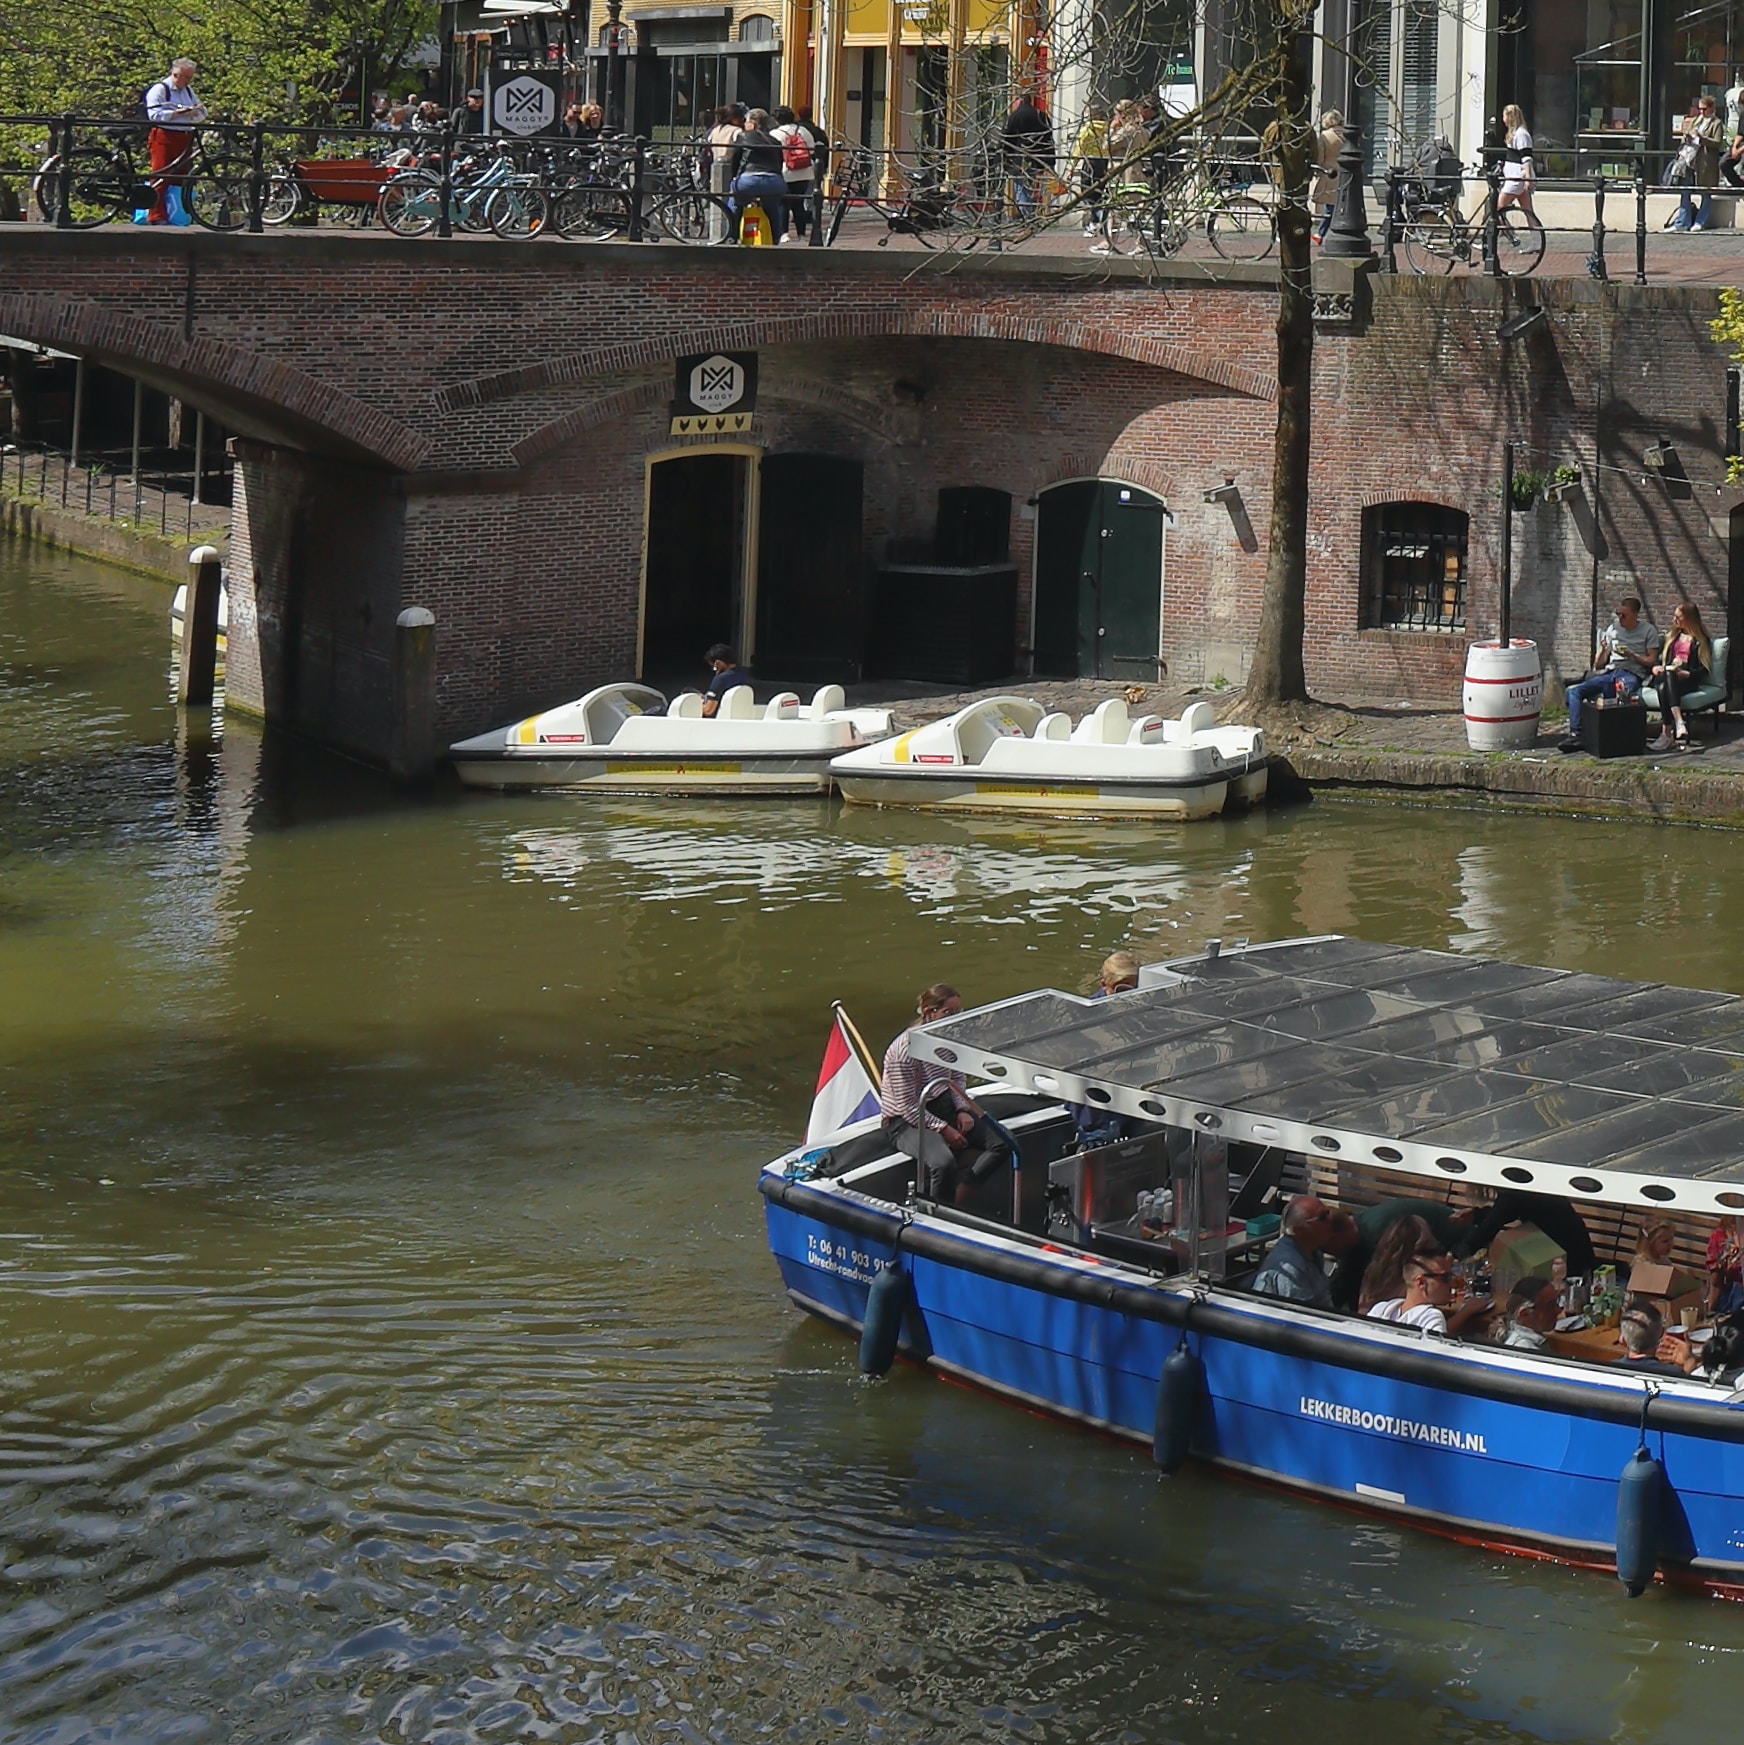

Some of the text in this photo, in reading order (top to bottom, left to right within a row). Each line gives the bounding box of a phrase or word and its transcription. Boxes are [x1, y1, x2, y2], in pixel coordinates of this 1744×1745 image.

[1509, 685, 1539, 699] LILLET
[807, 1234, 817, 1249] T:
[820, 1239, 832, 1255] 06
[835, 1245, 846, 1260] 41
[851, 1250, 869, 1268] 903
[1300, 1396, 1488, 1454] LEKKERBOOTJEVAREN.NL
